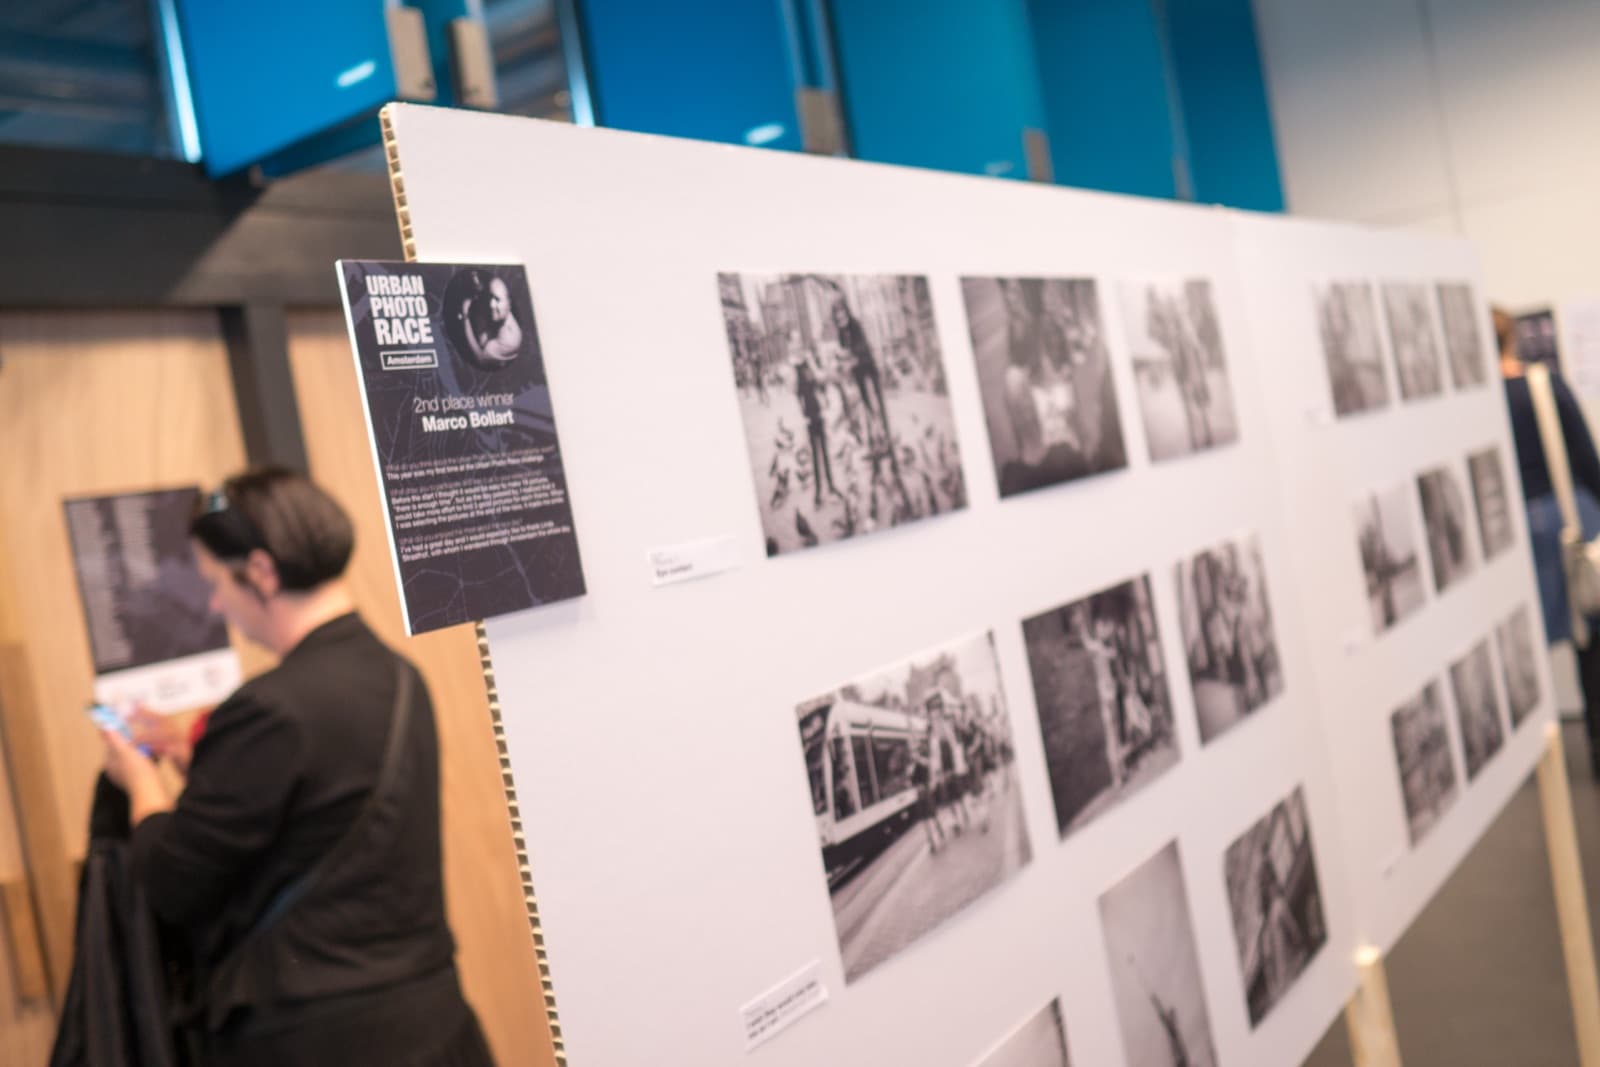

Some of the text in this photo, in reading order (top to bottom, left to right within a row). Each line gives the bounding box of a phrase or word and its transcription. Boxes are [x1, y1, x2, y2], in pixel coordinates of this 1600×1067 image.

[365, 275, 425, 296] URBAN
[369, 296, 429, 318] PHOTO
[373, 318, 434, 345] RACE
[387, 355, 432, 365] Amsterdam
[414, 391, 515, 414] 2nd place winner
[422, 409, 514, 432] Marco Bollart
